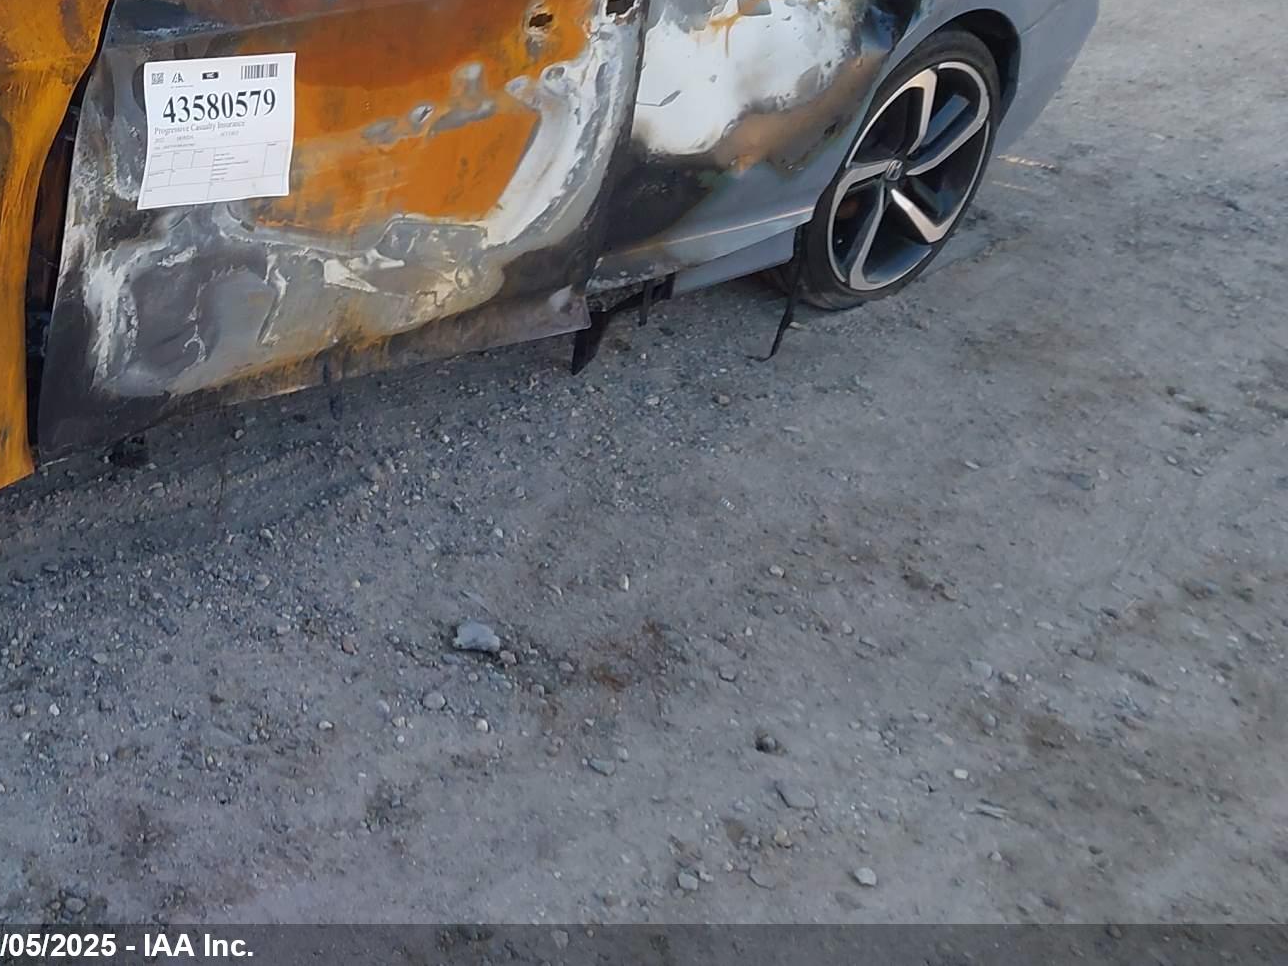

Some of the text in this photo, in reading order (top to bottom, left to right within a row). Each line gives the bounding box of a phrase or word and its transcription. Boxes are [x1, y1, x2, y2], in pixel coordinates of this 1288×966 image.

[163, 89, 276, 123] 43580579
[154, 120, 245, 136] Progressive Casualty Insurance
